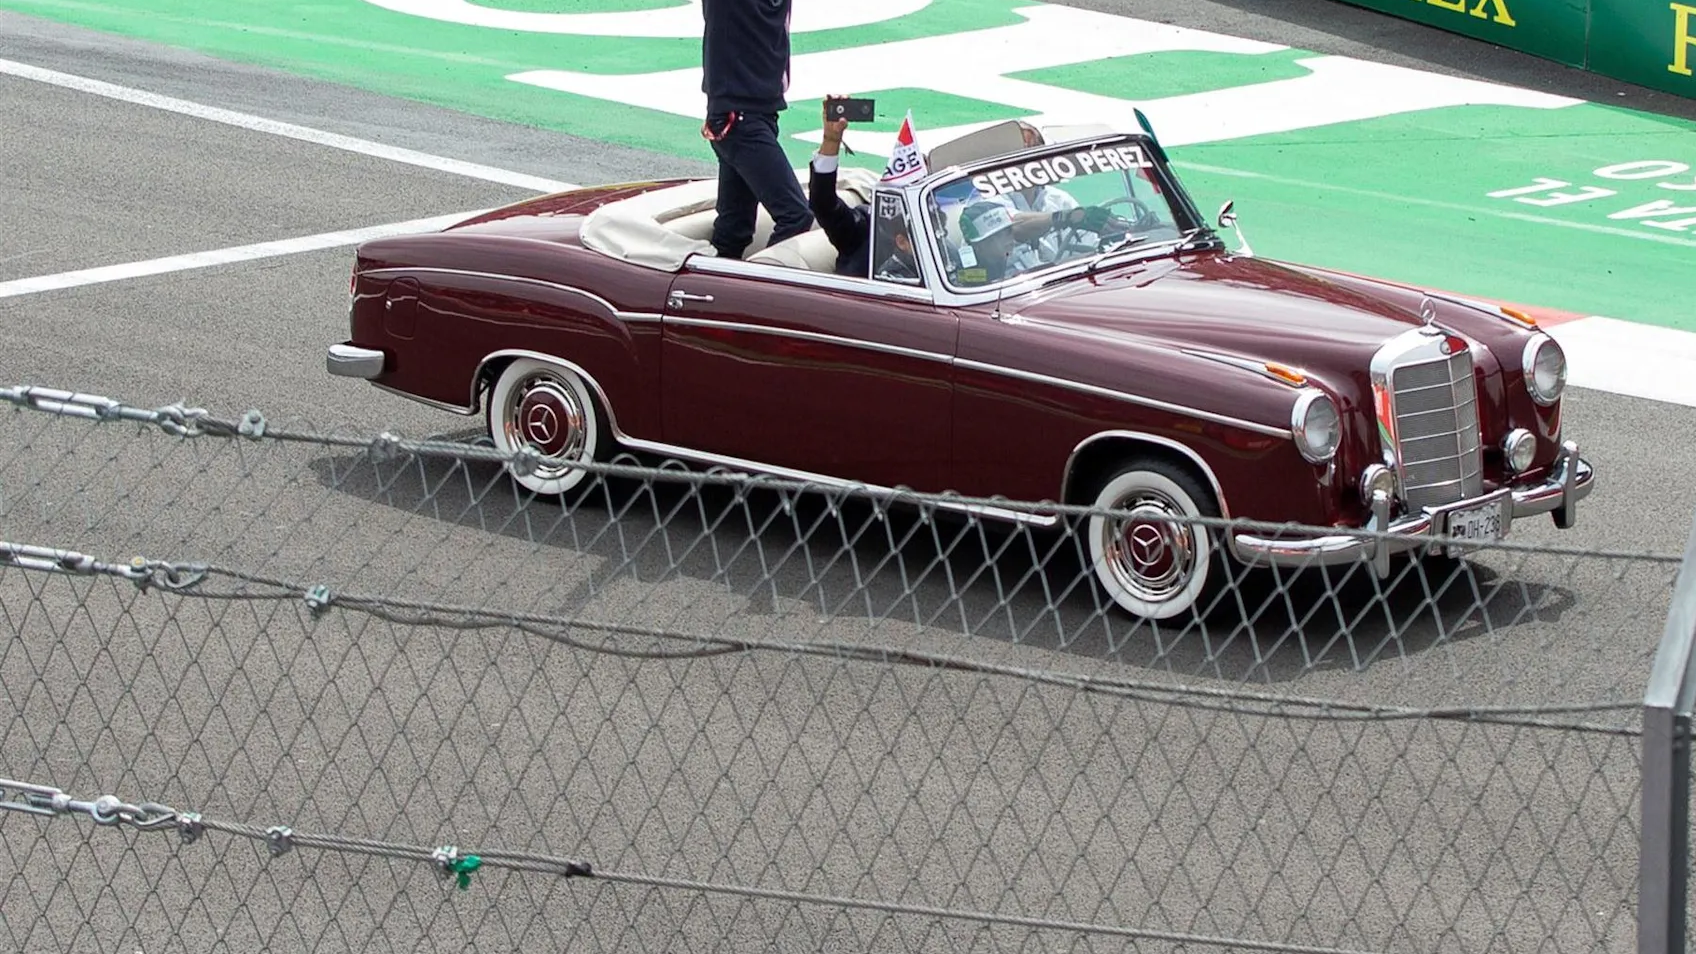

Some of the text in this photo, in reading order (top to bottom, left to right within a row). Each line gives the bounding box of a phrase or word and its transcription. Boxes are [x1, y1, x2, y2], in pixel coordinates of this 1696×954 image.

[971, 144, 1154, 198] SERGIO PÉREZ
[1486, 176, 1618, 207] EL
